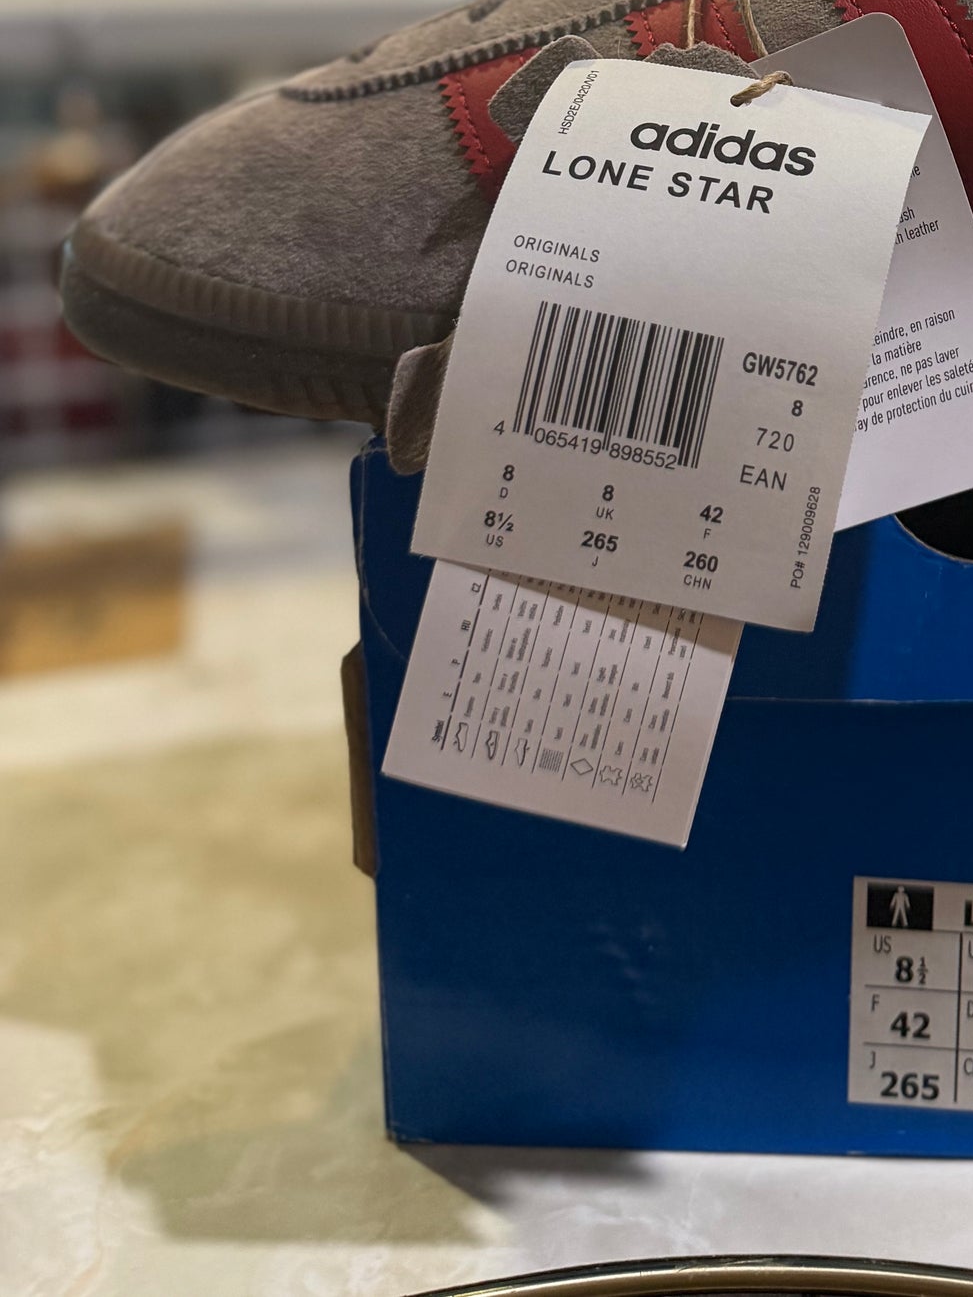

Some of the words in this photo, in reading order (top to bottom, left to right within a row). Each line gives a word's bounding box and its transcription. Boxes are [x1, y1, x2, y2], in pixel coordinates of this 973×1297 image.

[630, 121, 817, 177] adidas
[541, 150, 654, 191] LONE
[667, 171, 774, 215] STAR
[904, 220, 939, 240] leather
[513, 234, 600, 263] ORIGINALS
[505, 259, 594, 289] ORIGINALS
[873, 326, 908, 346] eindre,
[910, 320, 922, 333] en
[925, 309, 955, 328] raison
[871, 353, 881, 365] la
[885, 340, 922, 361] matière
[901, 363, 912, 376] ne
[915, 357, 933, 374] pas
[935, 347, 959, 363] laver
[742, 351, 819, 387] GW5762
[862, 392, 884, 411] pour
[887, 379, 923, 400] enlever
[926, 373, 941, 387] les
[872, 411, 884, 426] de
[887, 395, 937, 424] protection
[939, 389, 952, 402] du
[955, 381, 973, 397] cuir
[791, 400, 804, 417] 8
[493, 420, 505, 436] 4
[534, 427, 601, 455] 065419
[609, 442, 677, 470] 898552
[756, 427, 795, 452] 720
[502, 464, 515, 482] 8
[739, 464, 787, 491] EAN
[499, 487, 509, 499] D
[602, 484, 614, 502] 8
[596, 506, 614, 521] UK
[699, 504, 724, 524] 42
[797, 486, 821, 555] 129009628
[486, 533, 504, 548] US
[580, 530, 619, 552] 265
[703, 528, 711, 539] F
[591, 555, 599, 567] J
[683, 551, 719, 573] 260
[683, 574, 712, 590] CHN
[790, 561, 807, 589] PO#
[873, 935, 892, 953] US
[871, 994, 880, 1012] F
[890, 1012, 931, 1040] 42
[869, 1051, 876, 1069] J
[880, 1071, 940, 1101] 265
